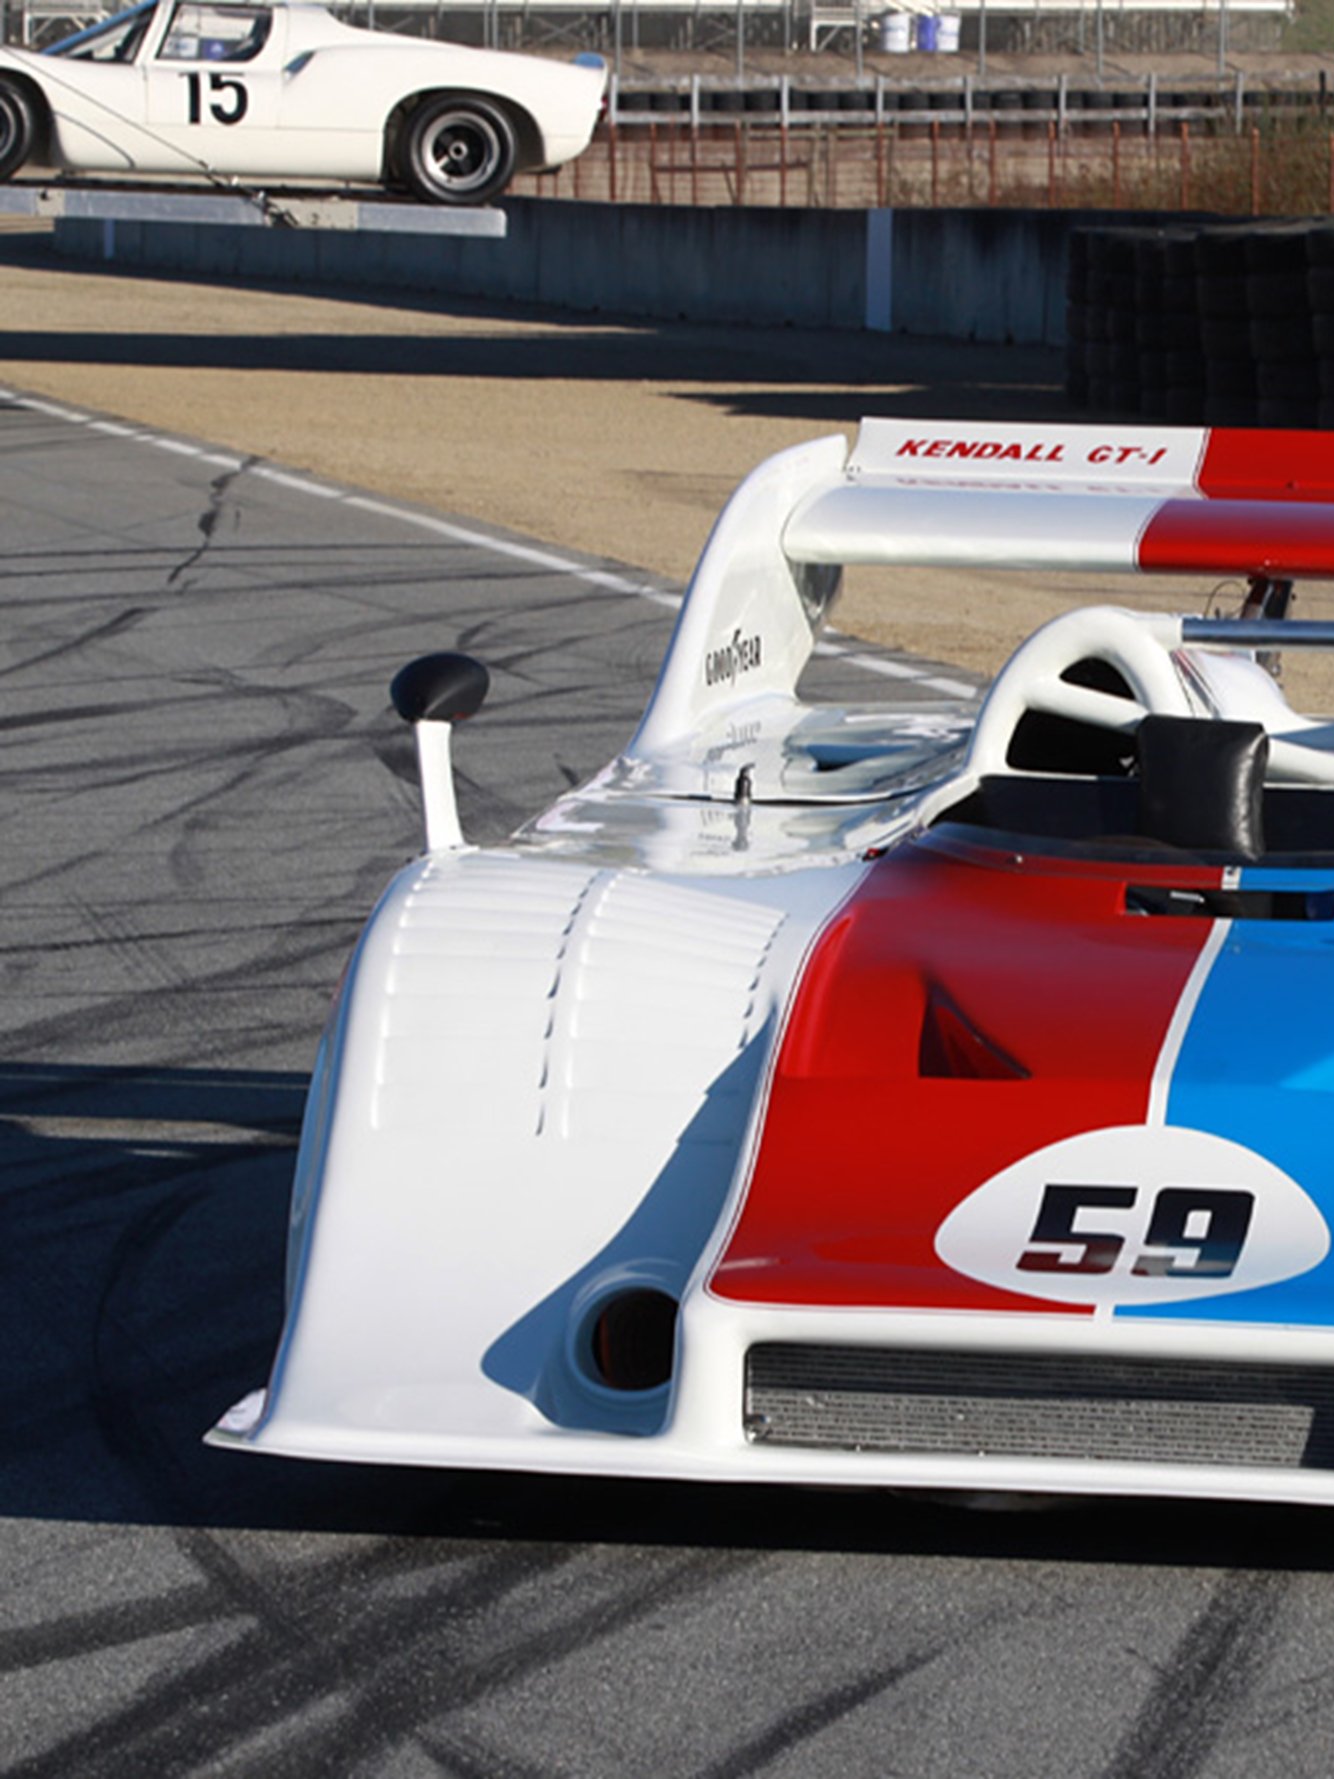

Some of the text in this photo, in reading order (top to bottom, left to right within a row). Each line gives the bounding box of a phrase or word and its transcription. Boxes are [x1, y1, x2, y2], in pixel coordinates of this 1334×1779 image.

[179, 71, 248, 125] 15
[896, 439, 1065, 462] KENDALL
[1015, 1184, 1256, 1279] 59
